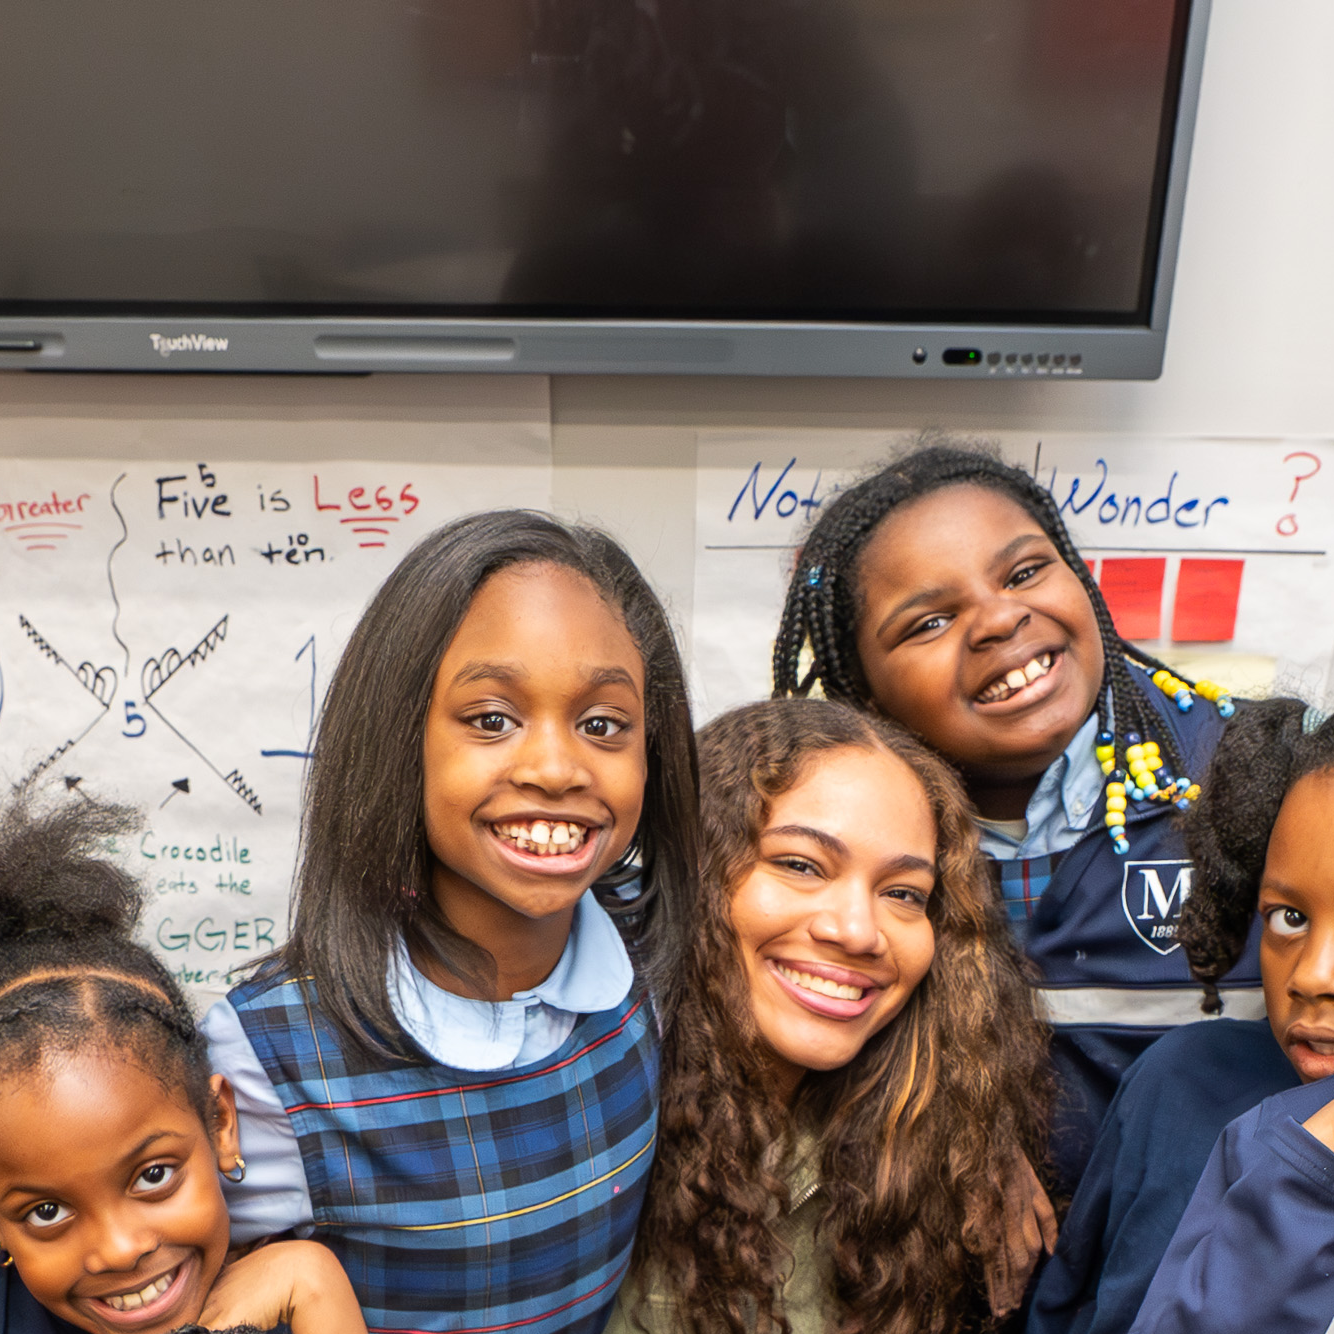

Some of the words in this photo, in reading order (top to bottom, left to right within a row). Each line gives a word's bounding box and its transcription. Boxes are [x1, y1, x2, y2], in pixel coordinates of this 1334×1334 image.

[150, 333, 229, 357] TouchView
[155, 475, 232, 520] Five
[256, 483, 292, 513] is
[313, 474, 420, 515] Less
[727, 457, 825, 523] Not
[1051, 457, 1230, 529] Wonder
[155, 538, 235, 567] than
[261, 634, 316, 759] 1
[122, 701, 148, 738] 5
[139, 830, 252, 864] Crocodile
[155, 870, 199, 895] eats
[215, 872, 252, 895] the
[1136, 867, 1196, 920] M
[156, 916, 276, 951] GGER
